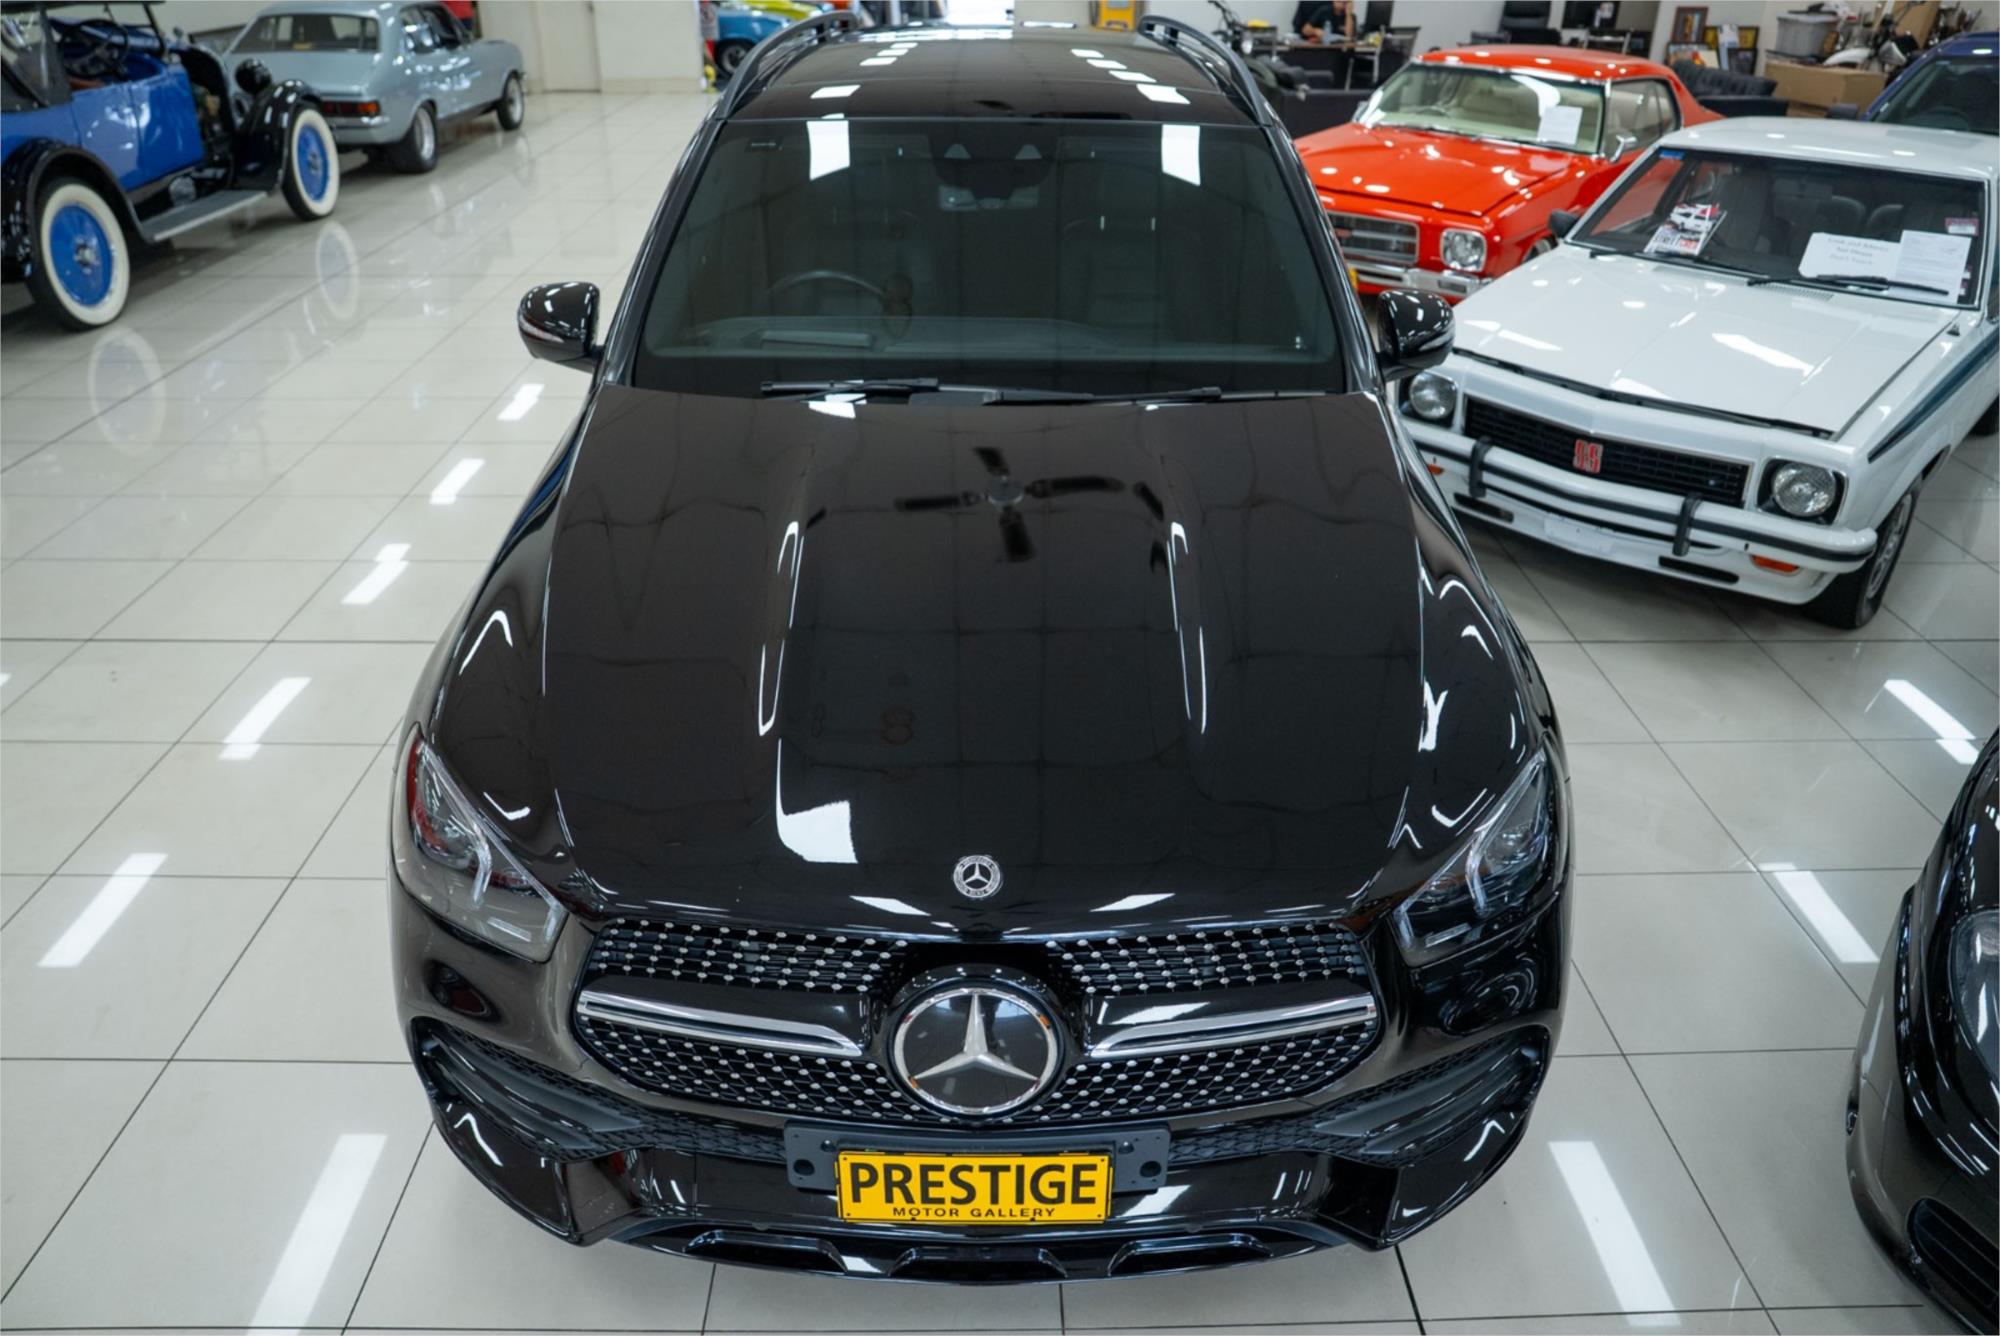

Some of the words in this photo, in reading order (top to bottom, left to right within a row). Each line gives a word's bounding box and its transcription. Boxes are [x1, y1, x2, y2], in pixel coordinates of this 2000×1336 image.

[850, 1162, 1097, 1206] PRESTIGE
[893, 1207, 960, 1217] MOTOR
[970, 1207, 1055, 1218] GALLERY
